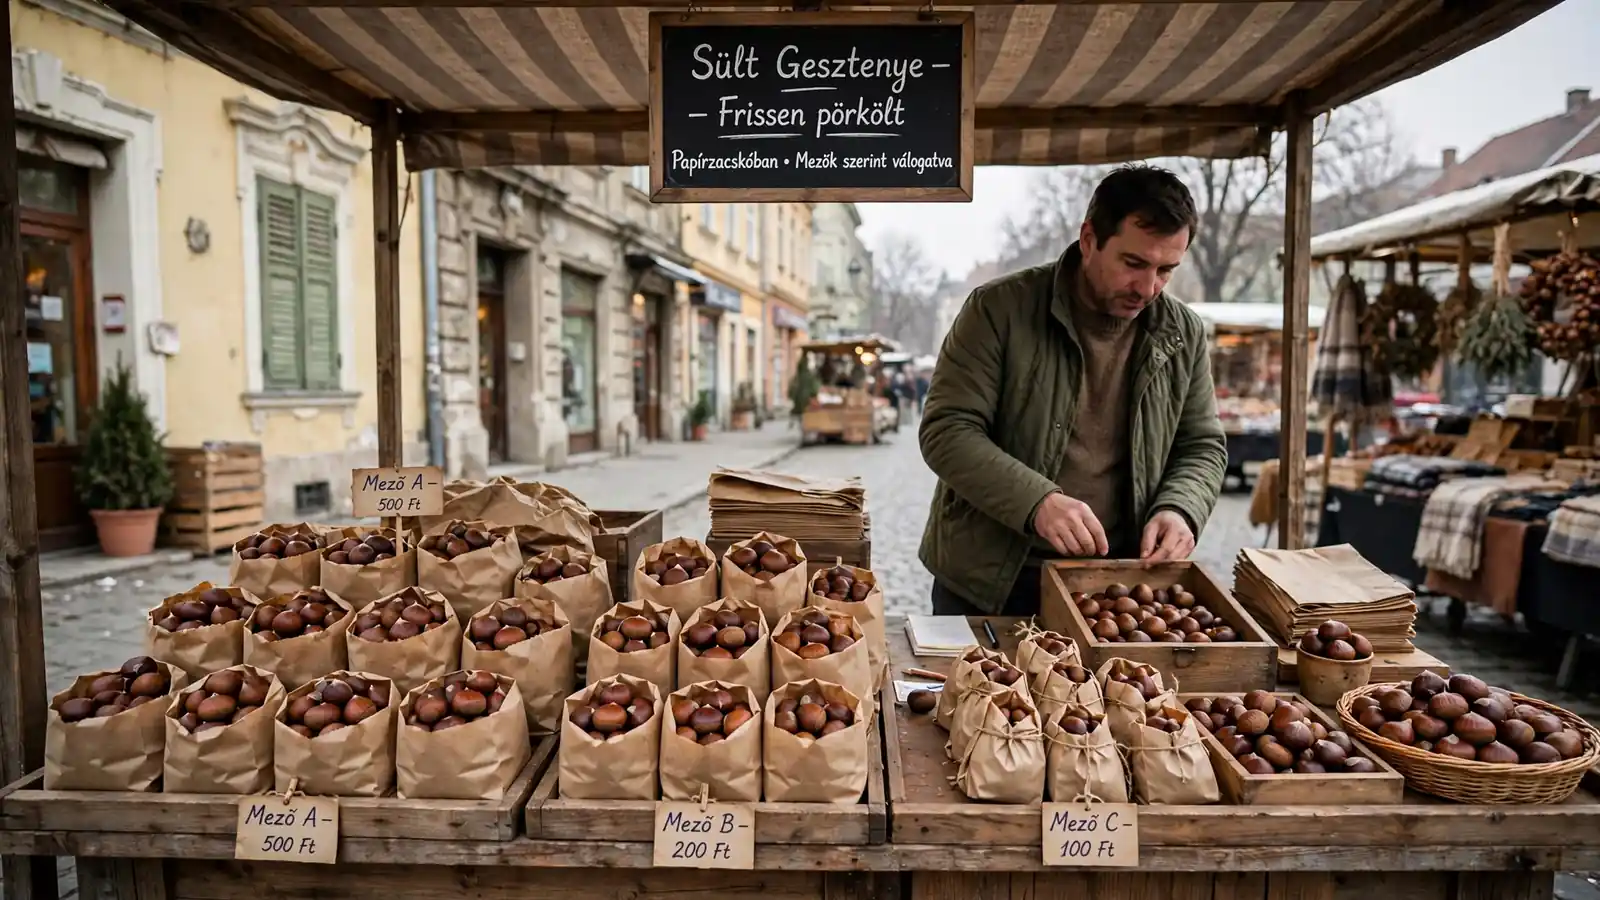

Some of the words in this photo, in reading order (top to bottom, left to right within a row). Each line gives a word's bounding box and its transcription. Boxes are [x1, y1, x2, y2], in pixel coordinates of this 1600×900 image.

[691, 42, 759, 80] Sült
[776, 44, 924, 94] Gesztenye
[718, 95, 806, 127] Frissen
[816, 96, 905, 138] pörkölt
[671, 149, 778, 176] Papírzacskóban
[842, 153, 887, 168] szerint
[892, 151, 953, 174] válogatva
[411, 474, 423, 490] A
[378, 498, 403, 511] 500
[408, 498, 421, 510] Ft
[302, 807, 316, 827] A
[720, 813, 734, 833] B
[1106, 812, 1119, 831] C
[262, 836, 294, 851] 500
[299, 838, 316, 854] Ft
[672, 841, 707, 858] 200
[713, 843, 730, 859] Ft
[1061, 841, 1091, 857] 100
[1098, 841, 1115, 857] Ft
